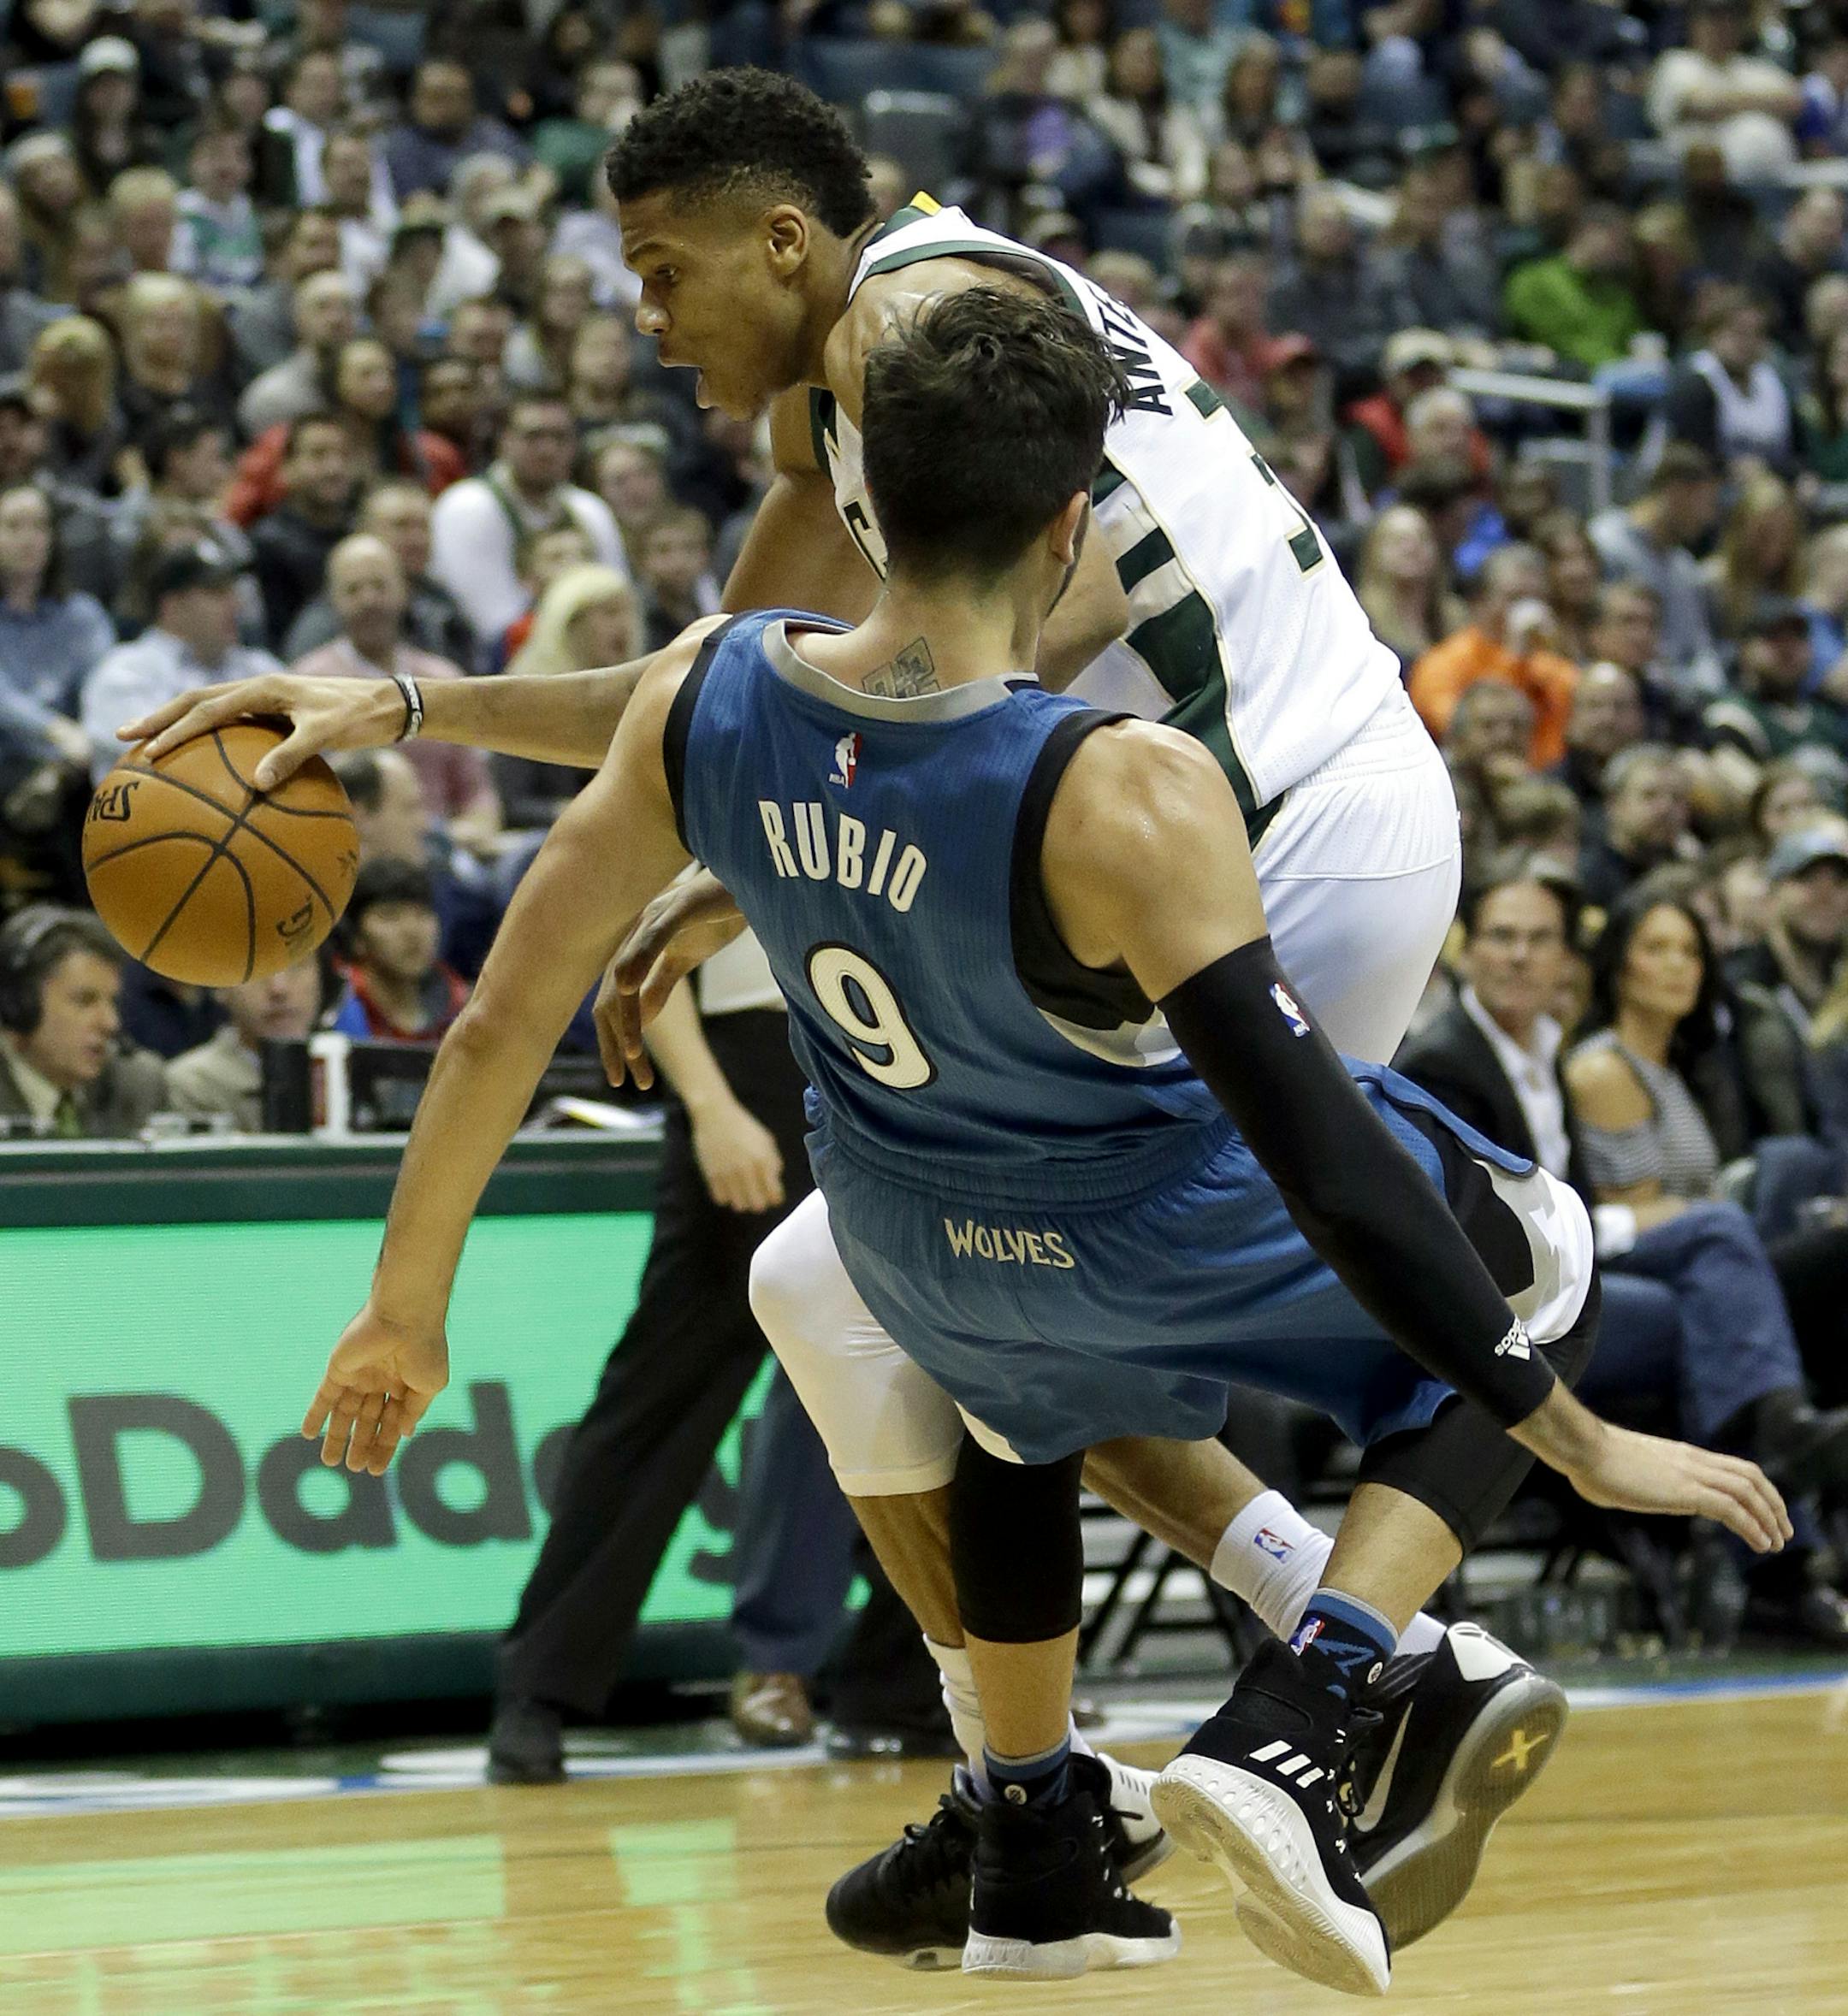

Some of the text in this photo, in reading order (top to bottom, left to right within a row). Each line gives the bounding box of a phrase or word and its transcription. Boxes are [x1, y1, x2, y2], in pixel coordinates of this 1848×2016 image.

[757, 800, 928, 914] RUBIO
[803, 941, 939, 1091] 9
[944, 1217, 1075, 1270] WOLVES
